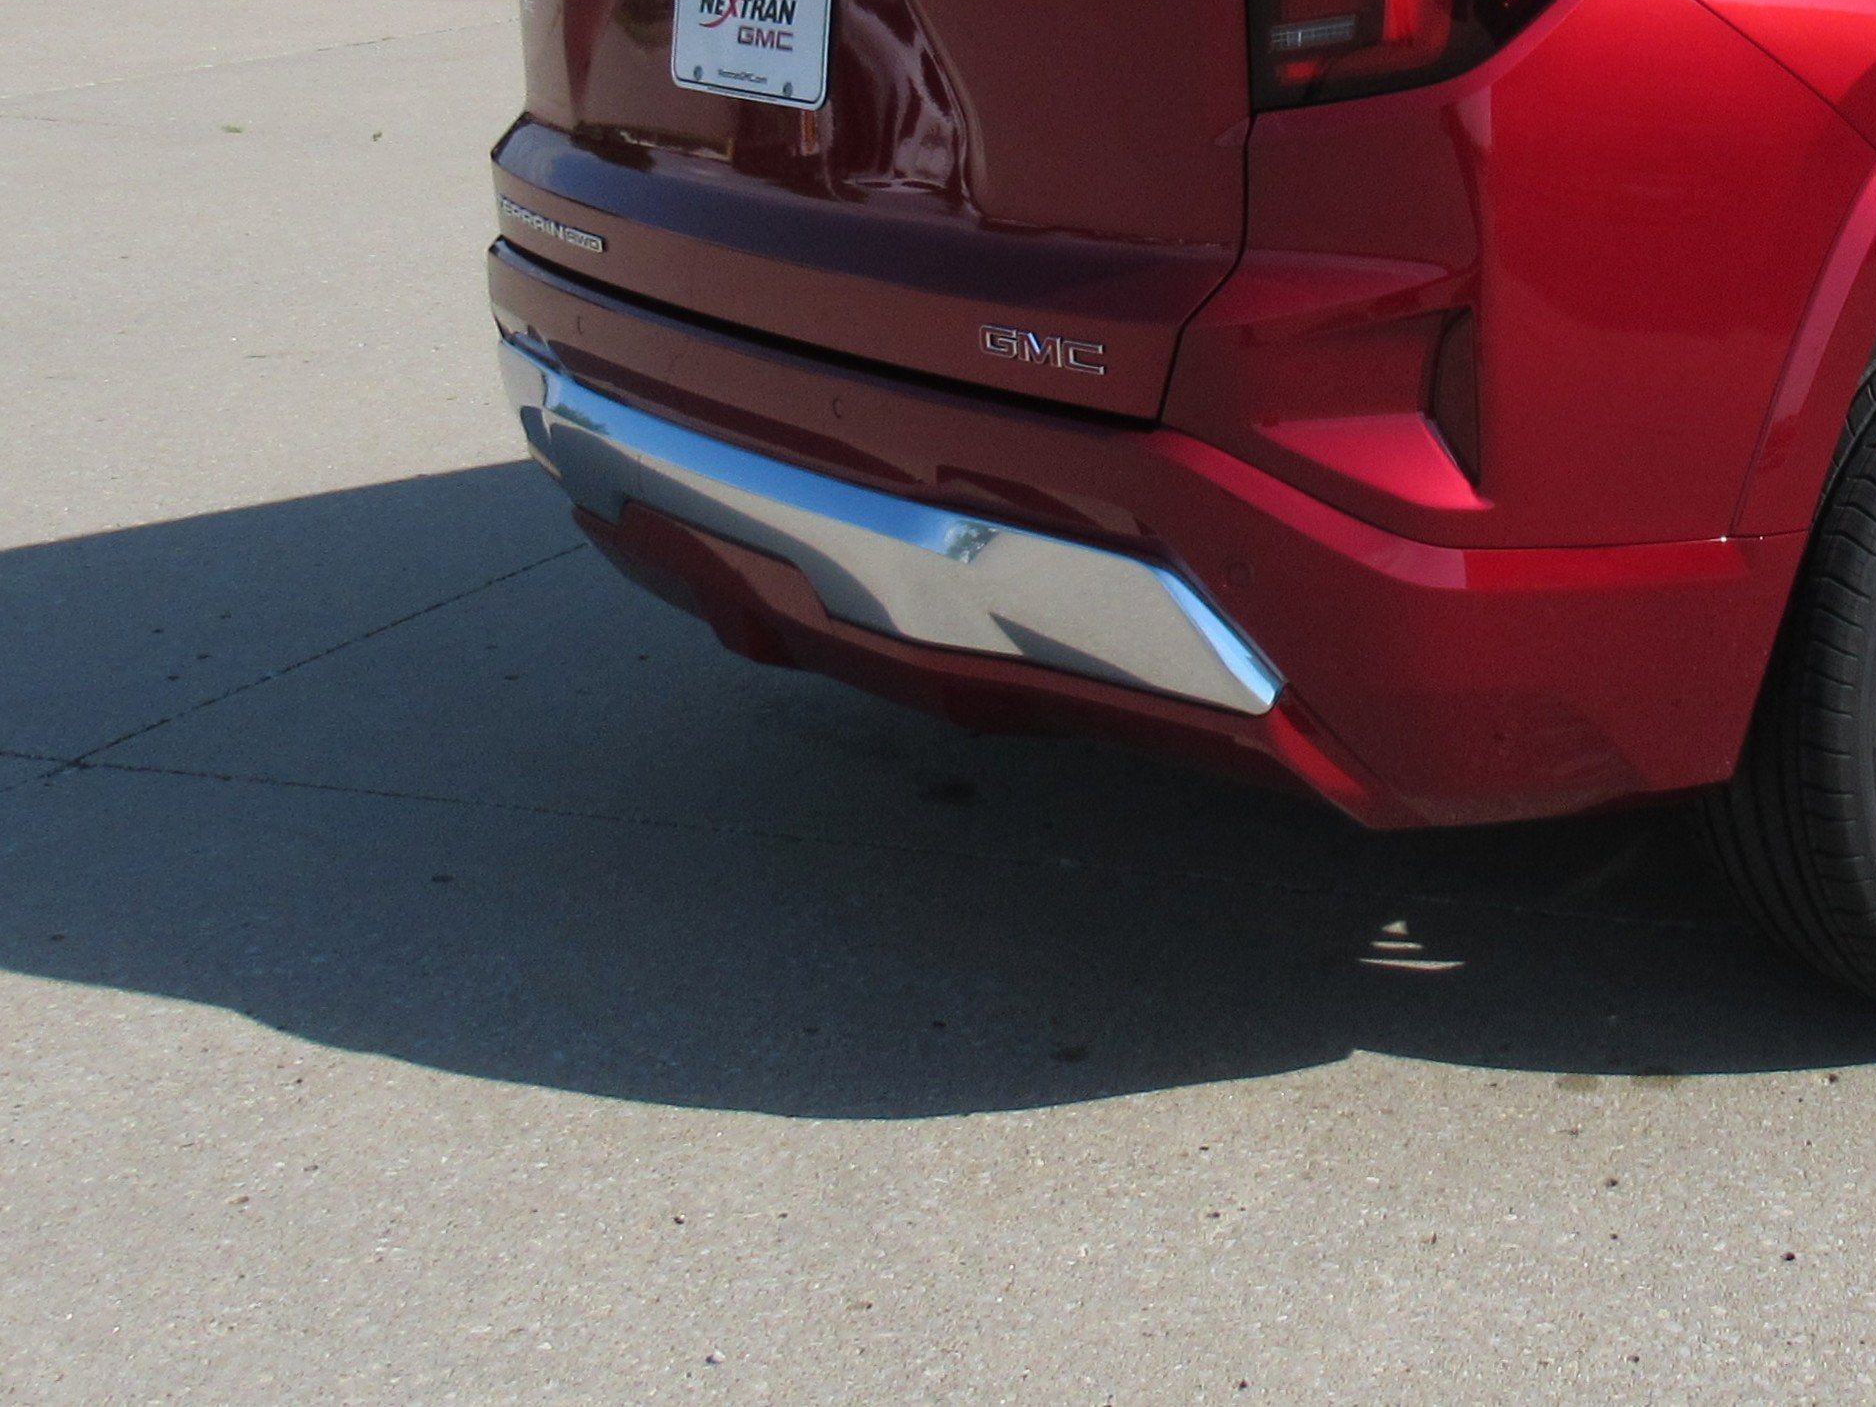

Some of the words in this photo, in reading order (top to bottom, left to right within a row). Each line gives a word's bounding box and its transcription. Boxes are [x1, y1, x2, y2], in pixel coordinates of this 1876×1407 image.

[738, 26, 794, 52] GMC
[500, 196, 565, 240] ERRAIN
[979, 324, 1105, 376] GMC
